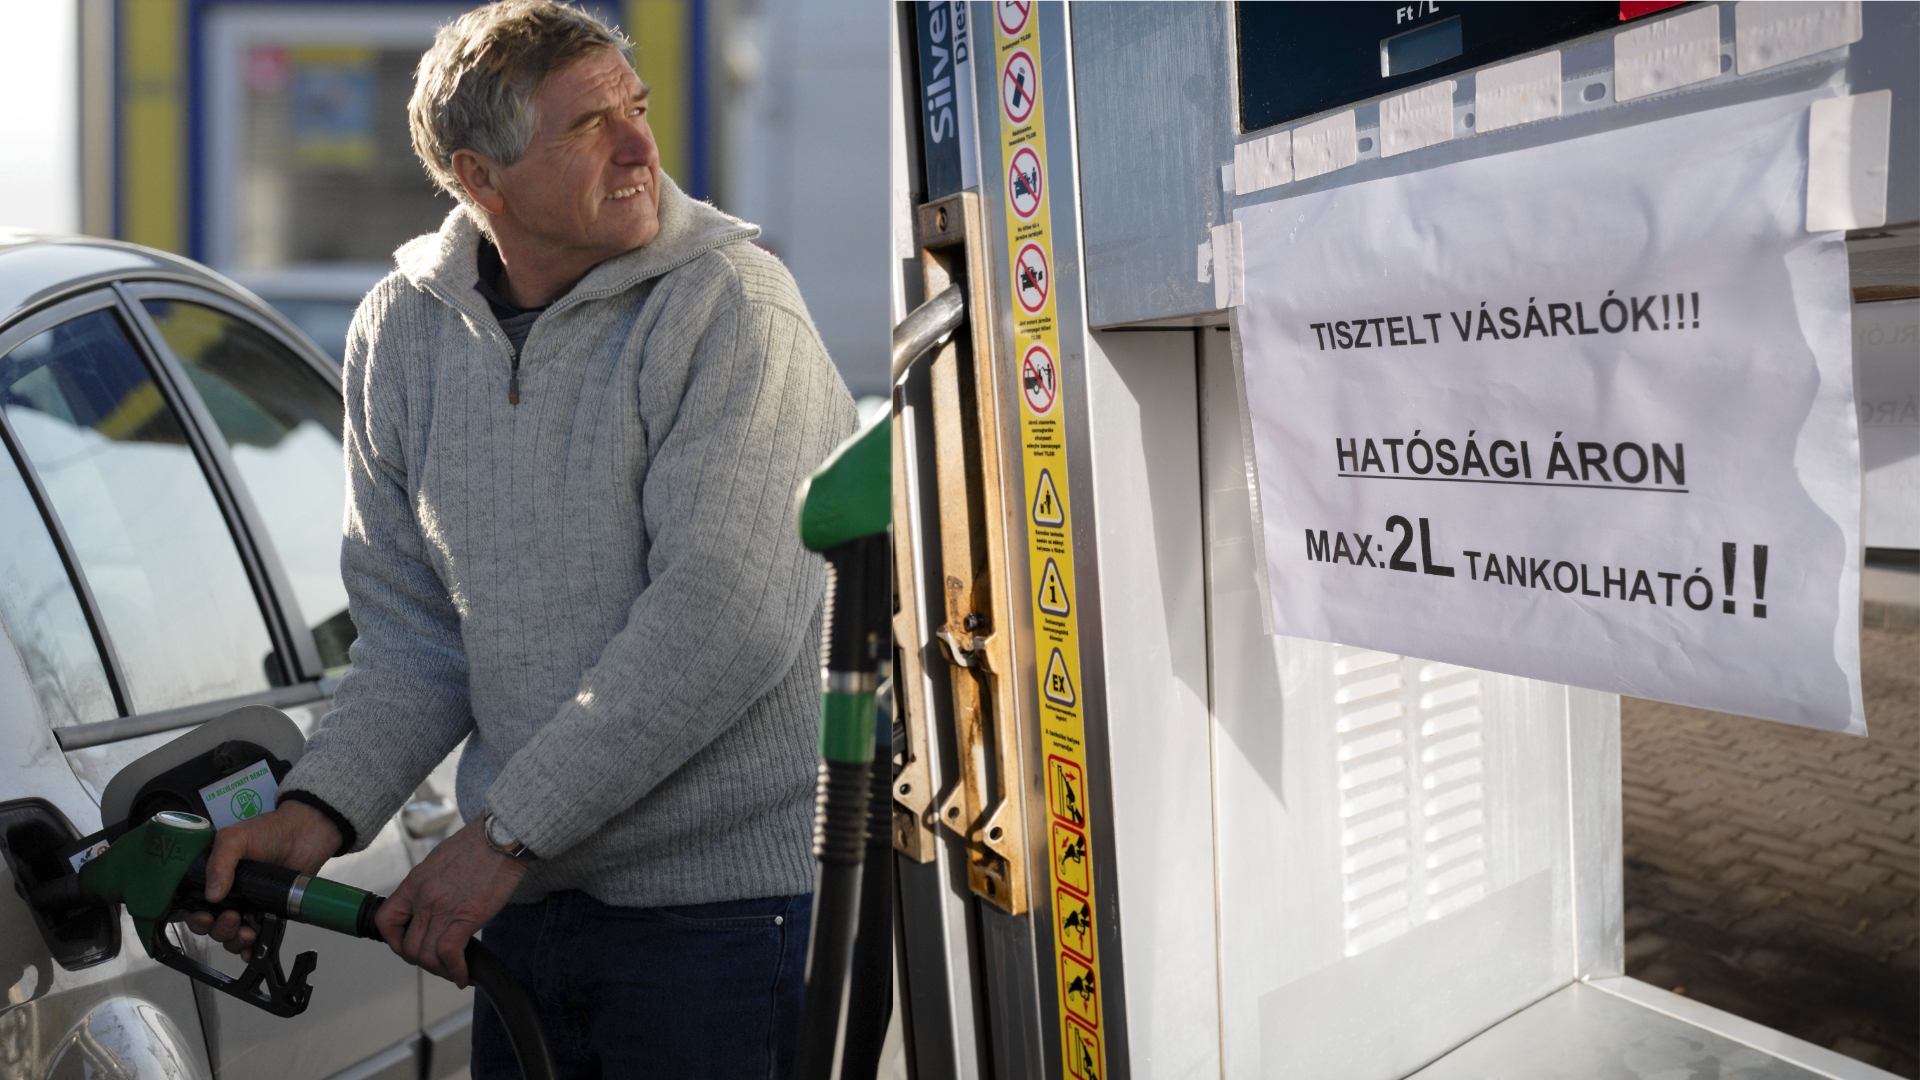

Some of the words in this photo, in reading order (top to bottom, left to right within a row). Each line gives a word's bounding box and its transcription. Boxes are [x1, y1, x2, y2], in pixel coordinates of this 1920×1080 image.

[1396, 5, 1414, 25] Ft
[1428, 1, 1440, 14] L
[1310, 313, 1442, 351] TISZTELT
[1449, 289, 1700, 342] VÁSÁRLÓK!!!
[1336, 430, 1532, 479] HATÓSÁGI
[1546, 431, 1686, 485] ÁRON
[1053, 674, 1065, 694] EX
[205, 793, 216, 802] LEN
